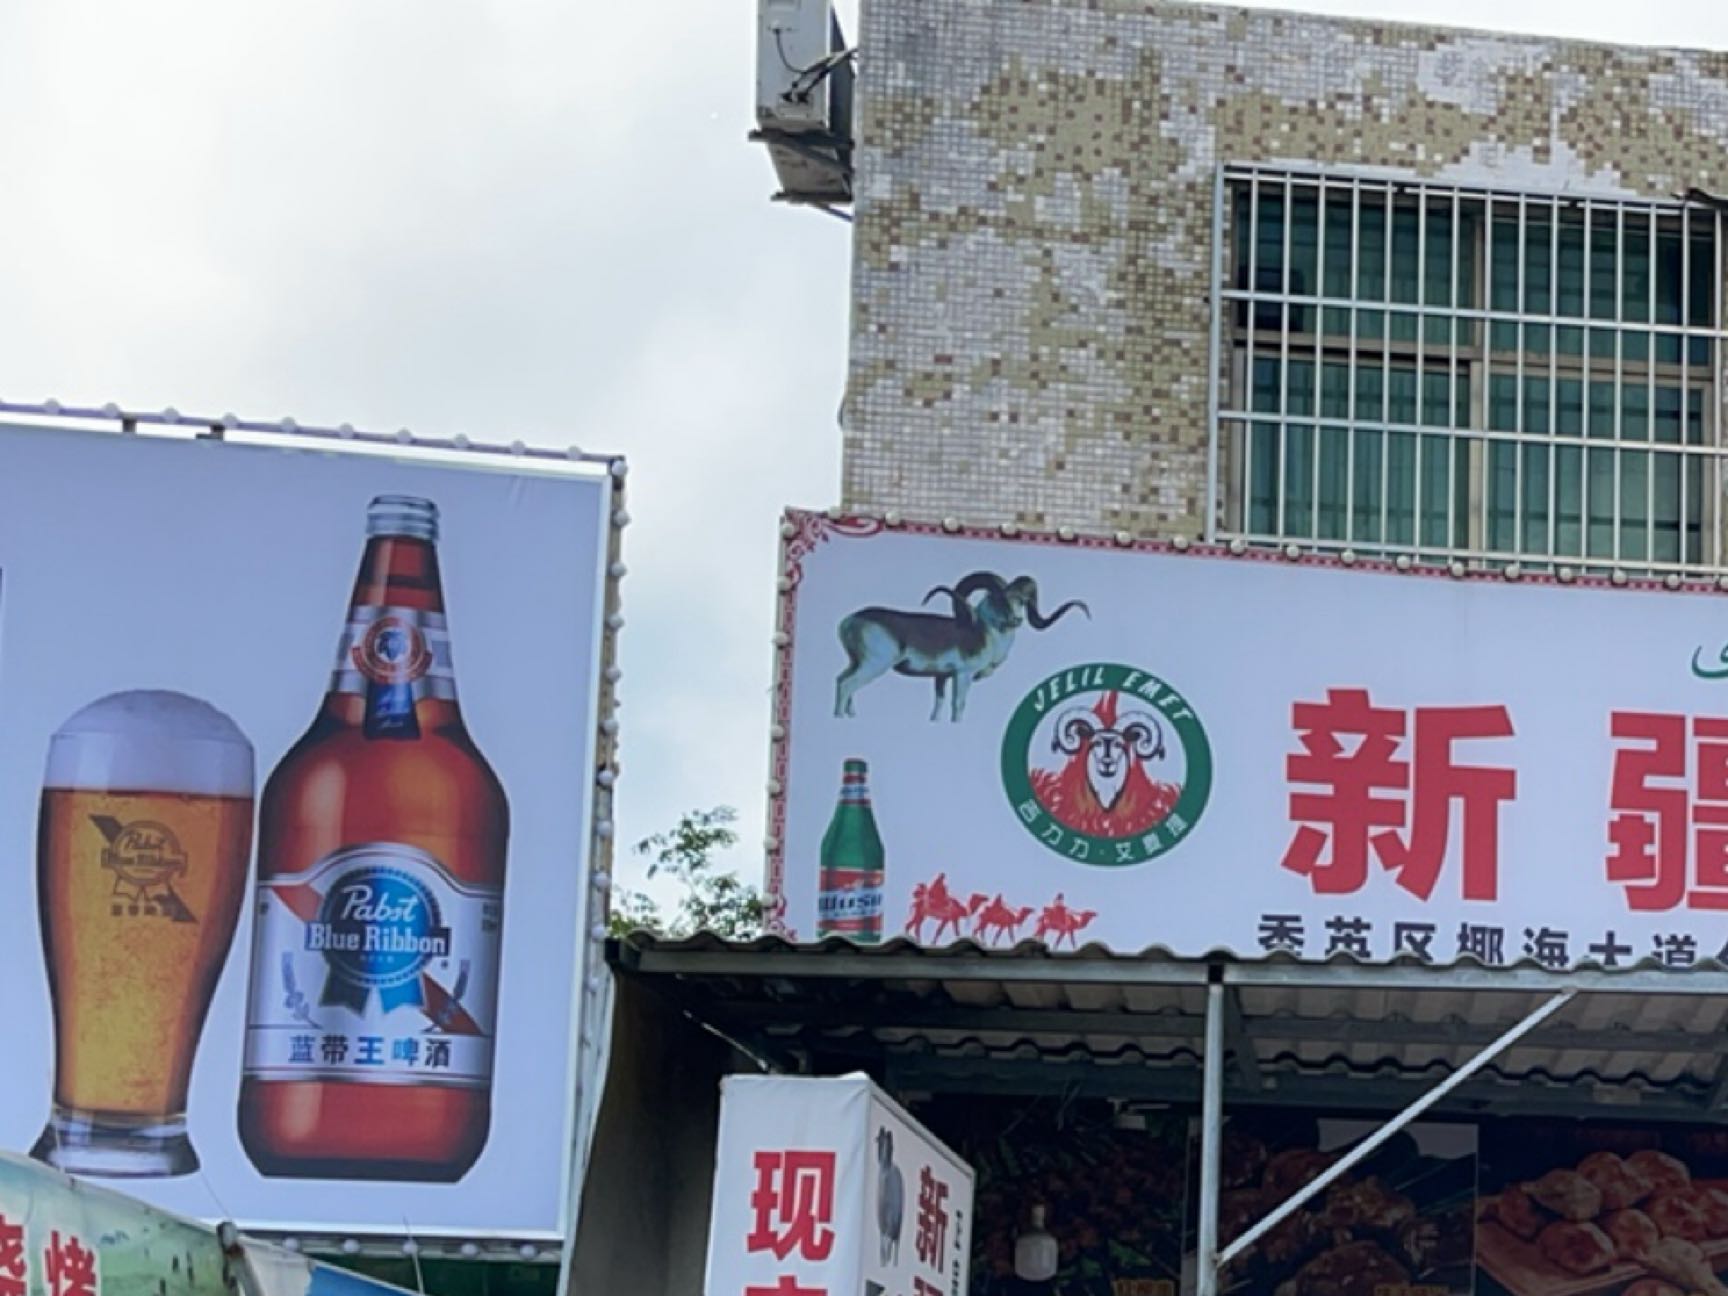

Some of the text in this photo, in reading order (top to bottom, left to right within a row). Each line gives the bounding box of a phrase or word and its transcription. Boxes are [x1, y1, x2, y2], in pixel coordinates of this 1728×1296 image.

[340, 885, 418, 922] Pabst
[308, 922, 447, 954] Blue Ribbon
[288, 1033, 451, 1068] 蓝带王啤酒
